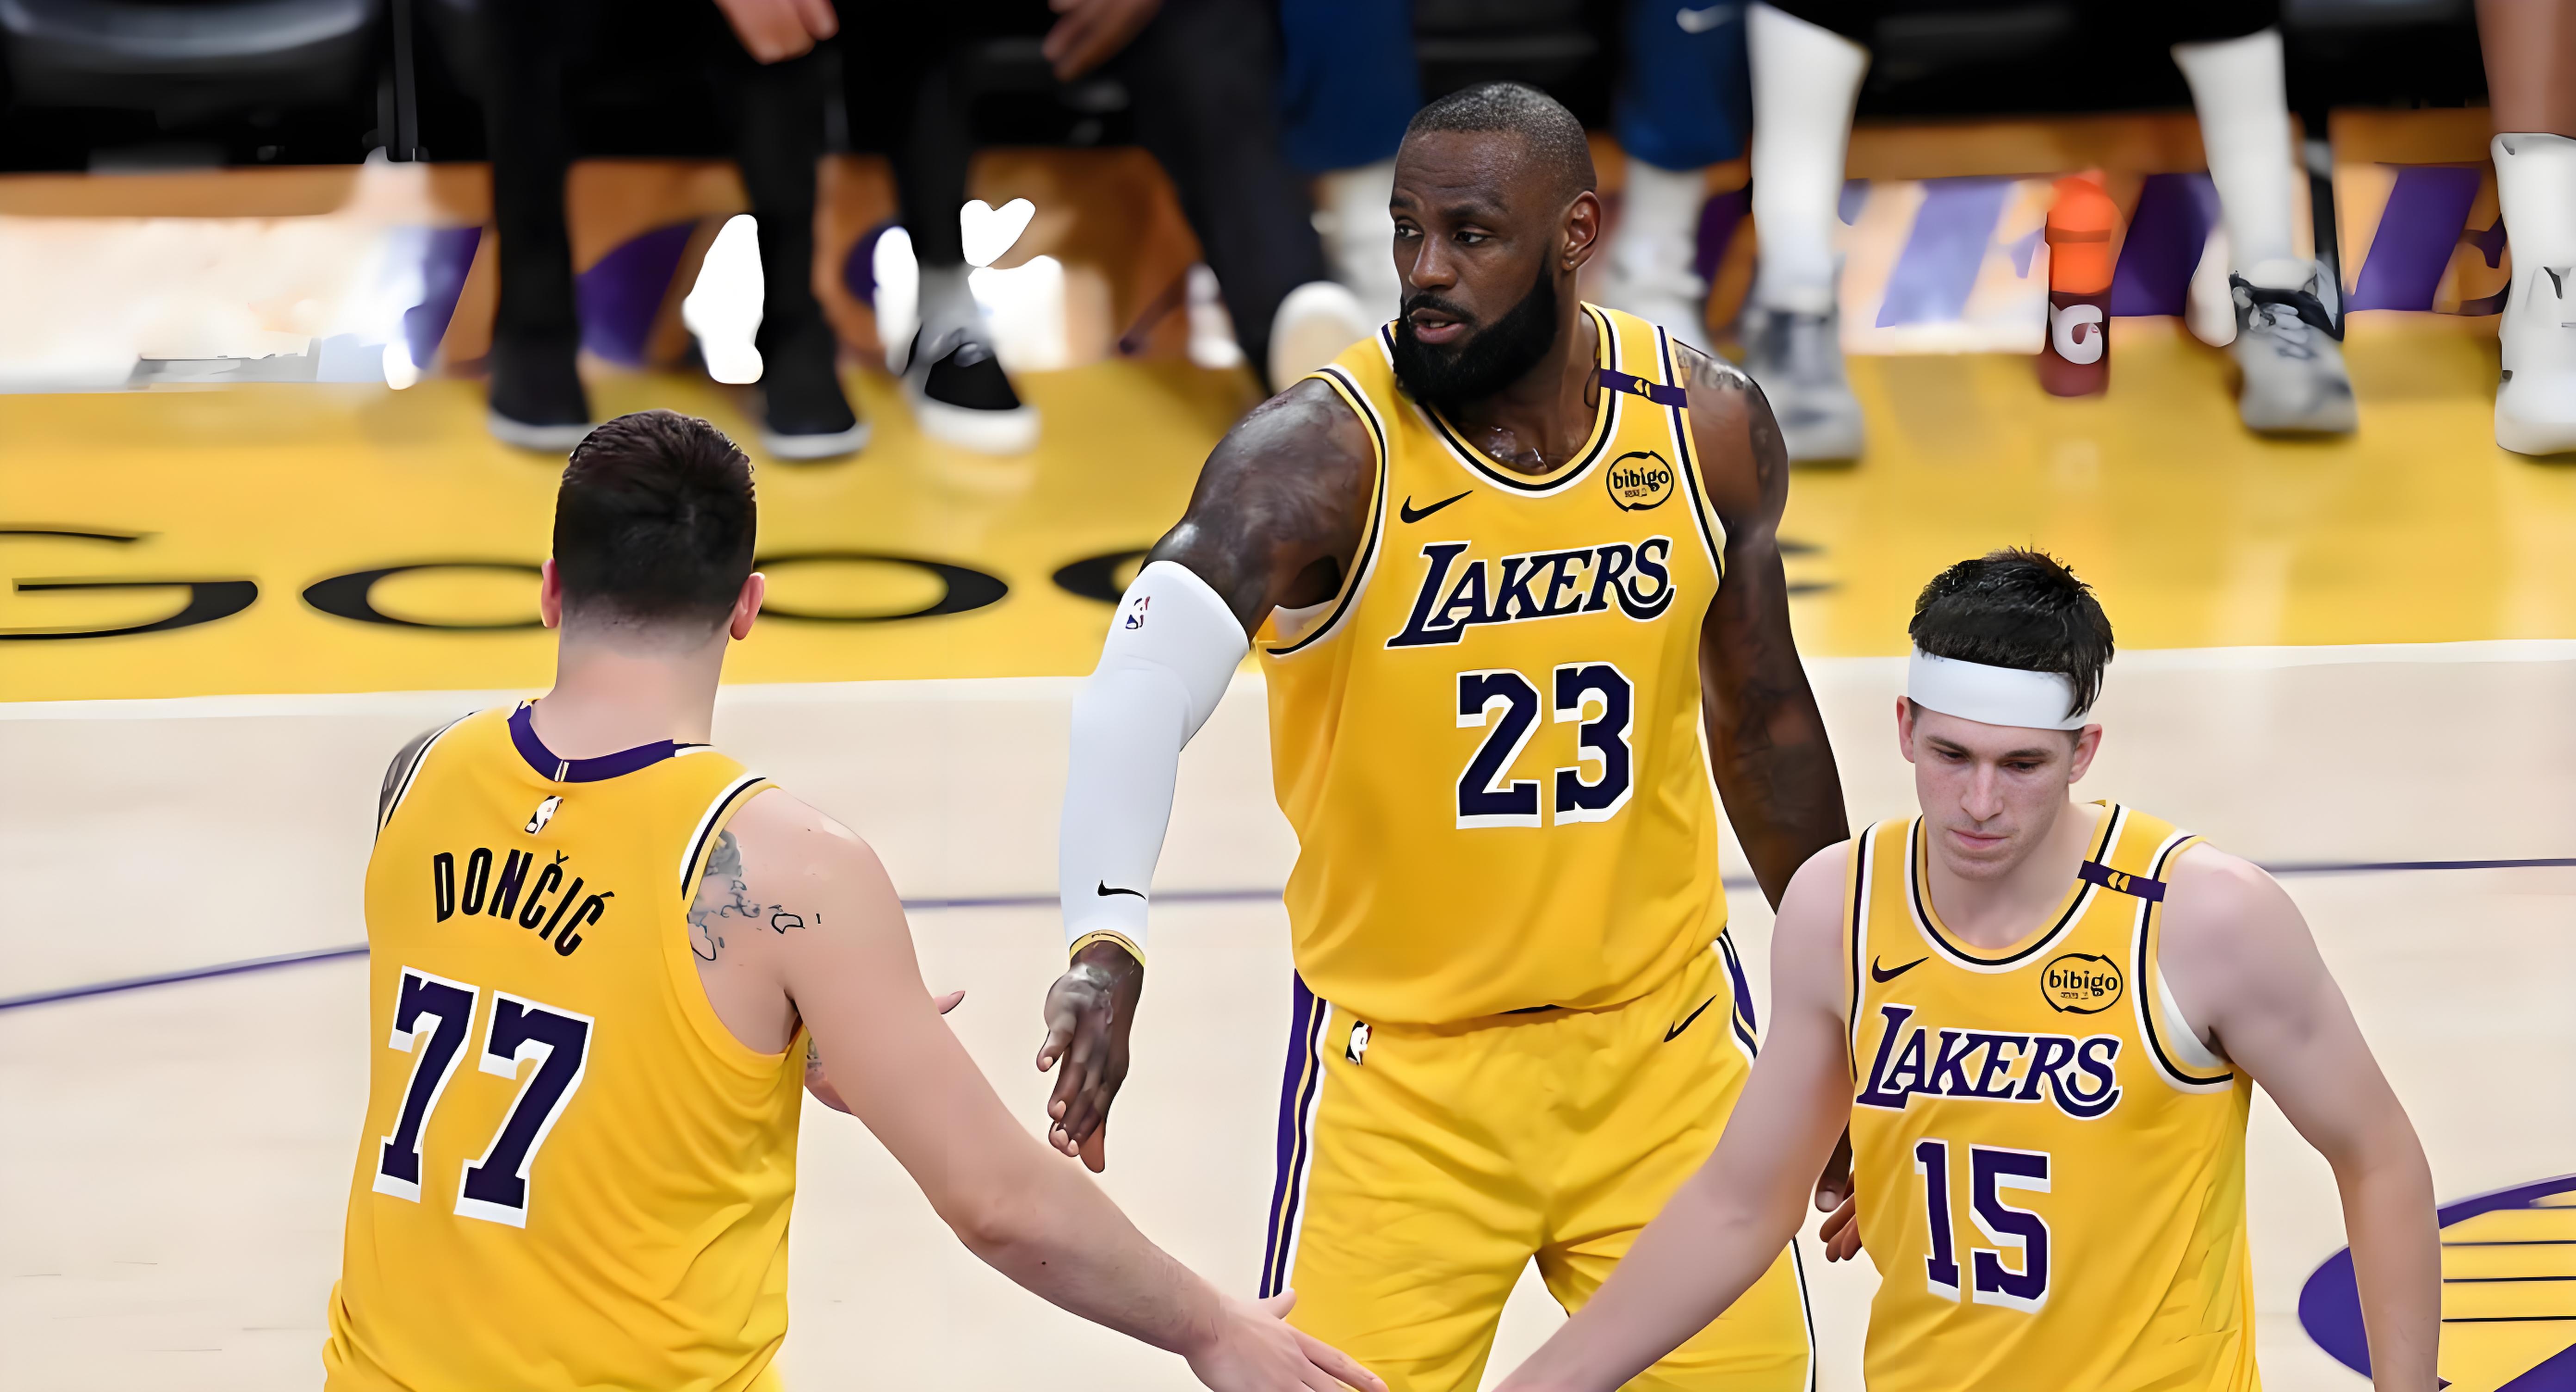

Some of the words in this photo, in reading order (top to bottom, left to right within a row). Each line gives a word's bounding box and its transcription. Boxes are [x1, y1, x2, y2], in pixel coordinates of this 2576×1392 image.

[1612, 467, 1669, 492] bibigo
[1384, 535, 1677, 650] LAKERS
[1456, 661, 1635, 829] 23
[433, 847, 614, 957] DONČIĆ
[2049, 969, 2118, 997] bibigo
[372, 965, 595, 1229] 77
[1855, 1003, 2124, 1120] LAKERS
[1913, 1137, 2051, 1315] 15
